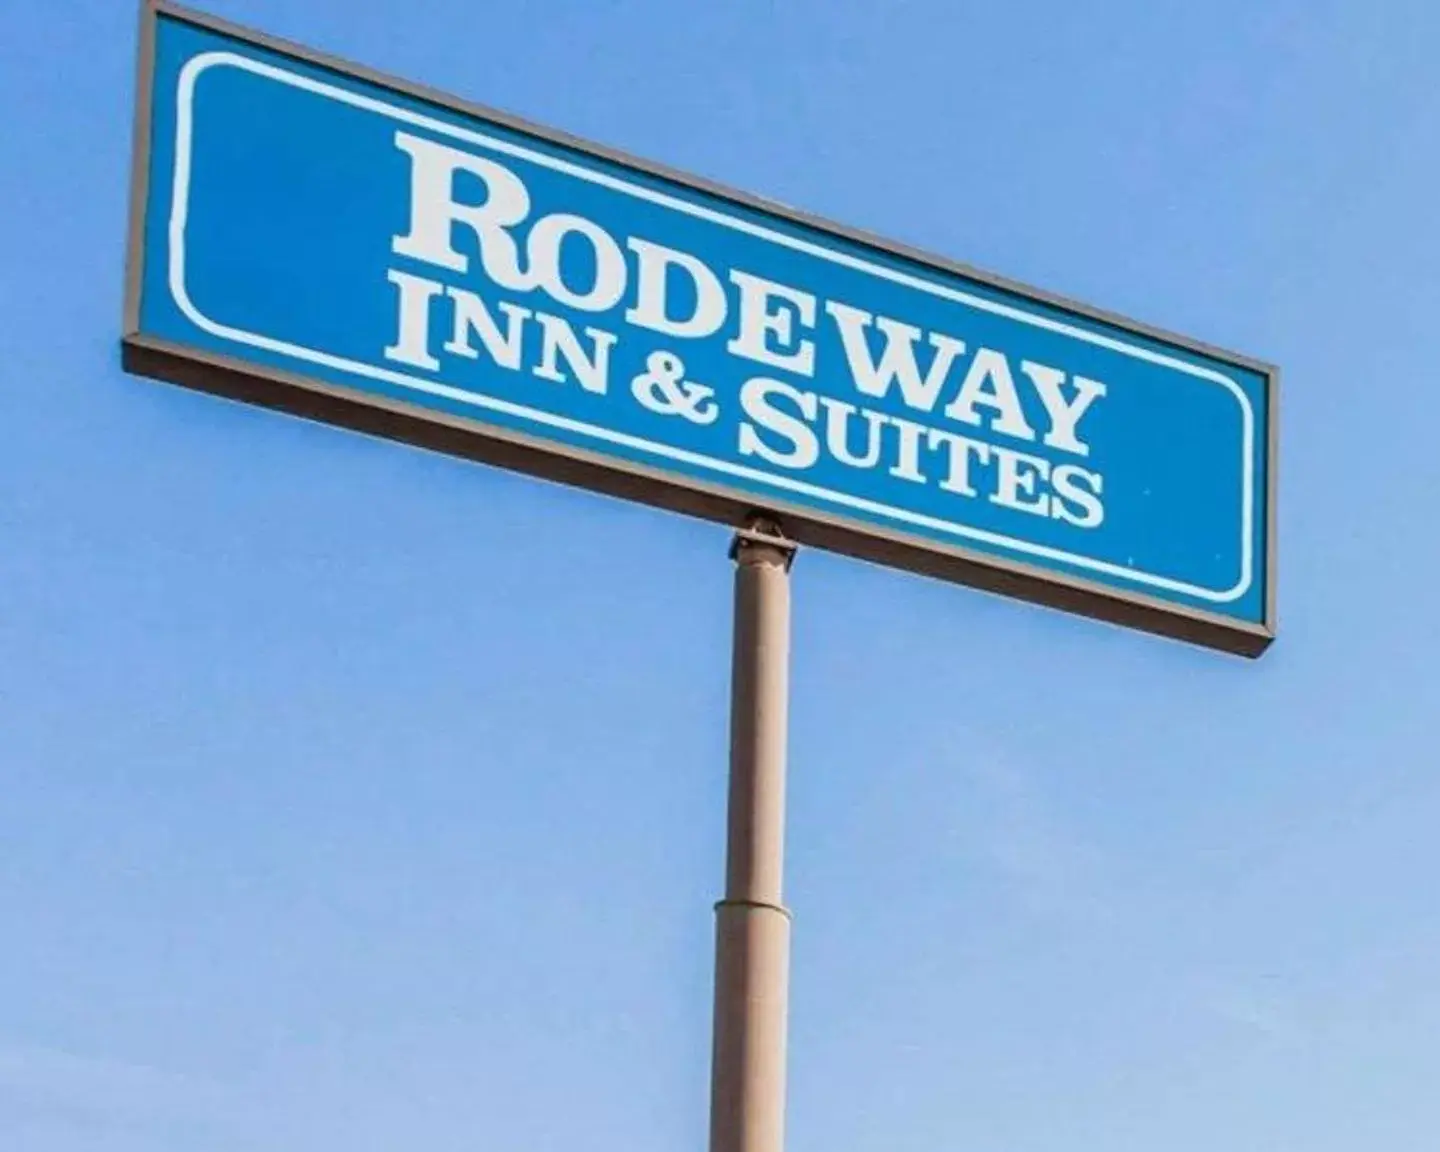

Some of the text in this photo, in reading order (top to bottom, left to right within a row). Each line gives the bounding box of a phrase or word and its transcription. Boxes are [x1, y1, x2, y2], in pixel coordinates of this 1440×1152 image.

[384, 269, 1104, 528] INN & SUITES
[391, 130, 1106, 456] RODEWAY
